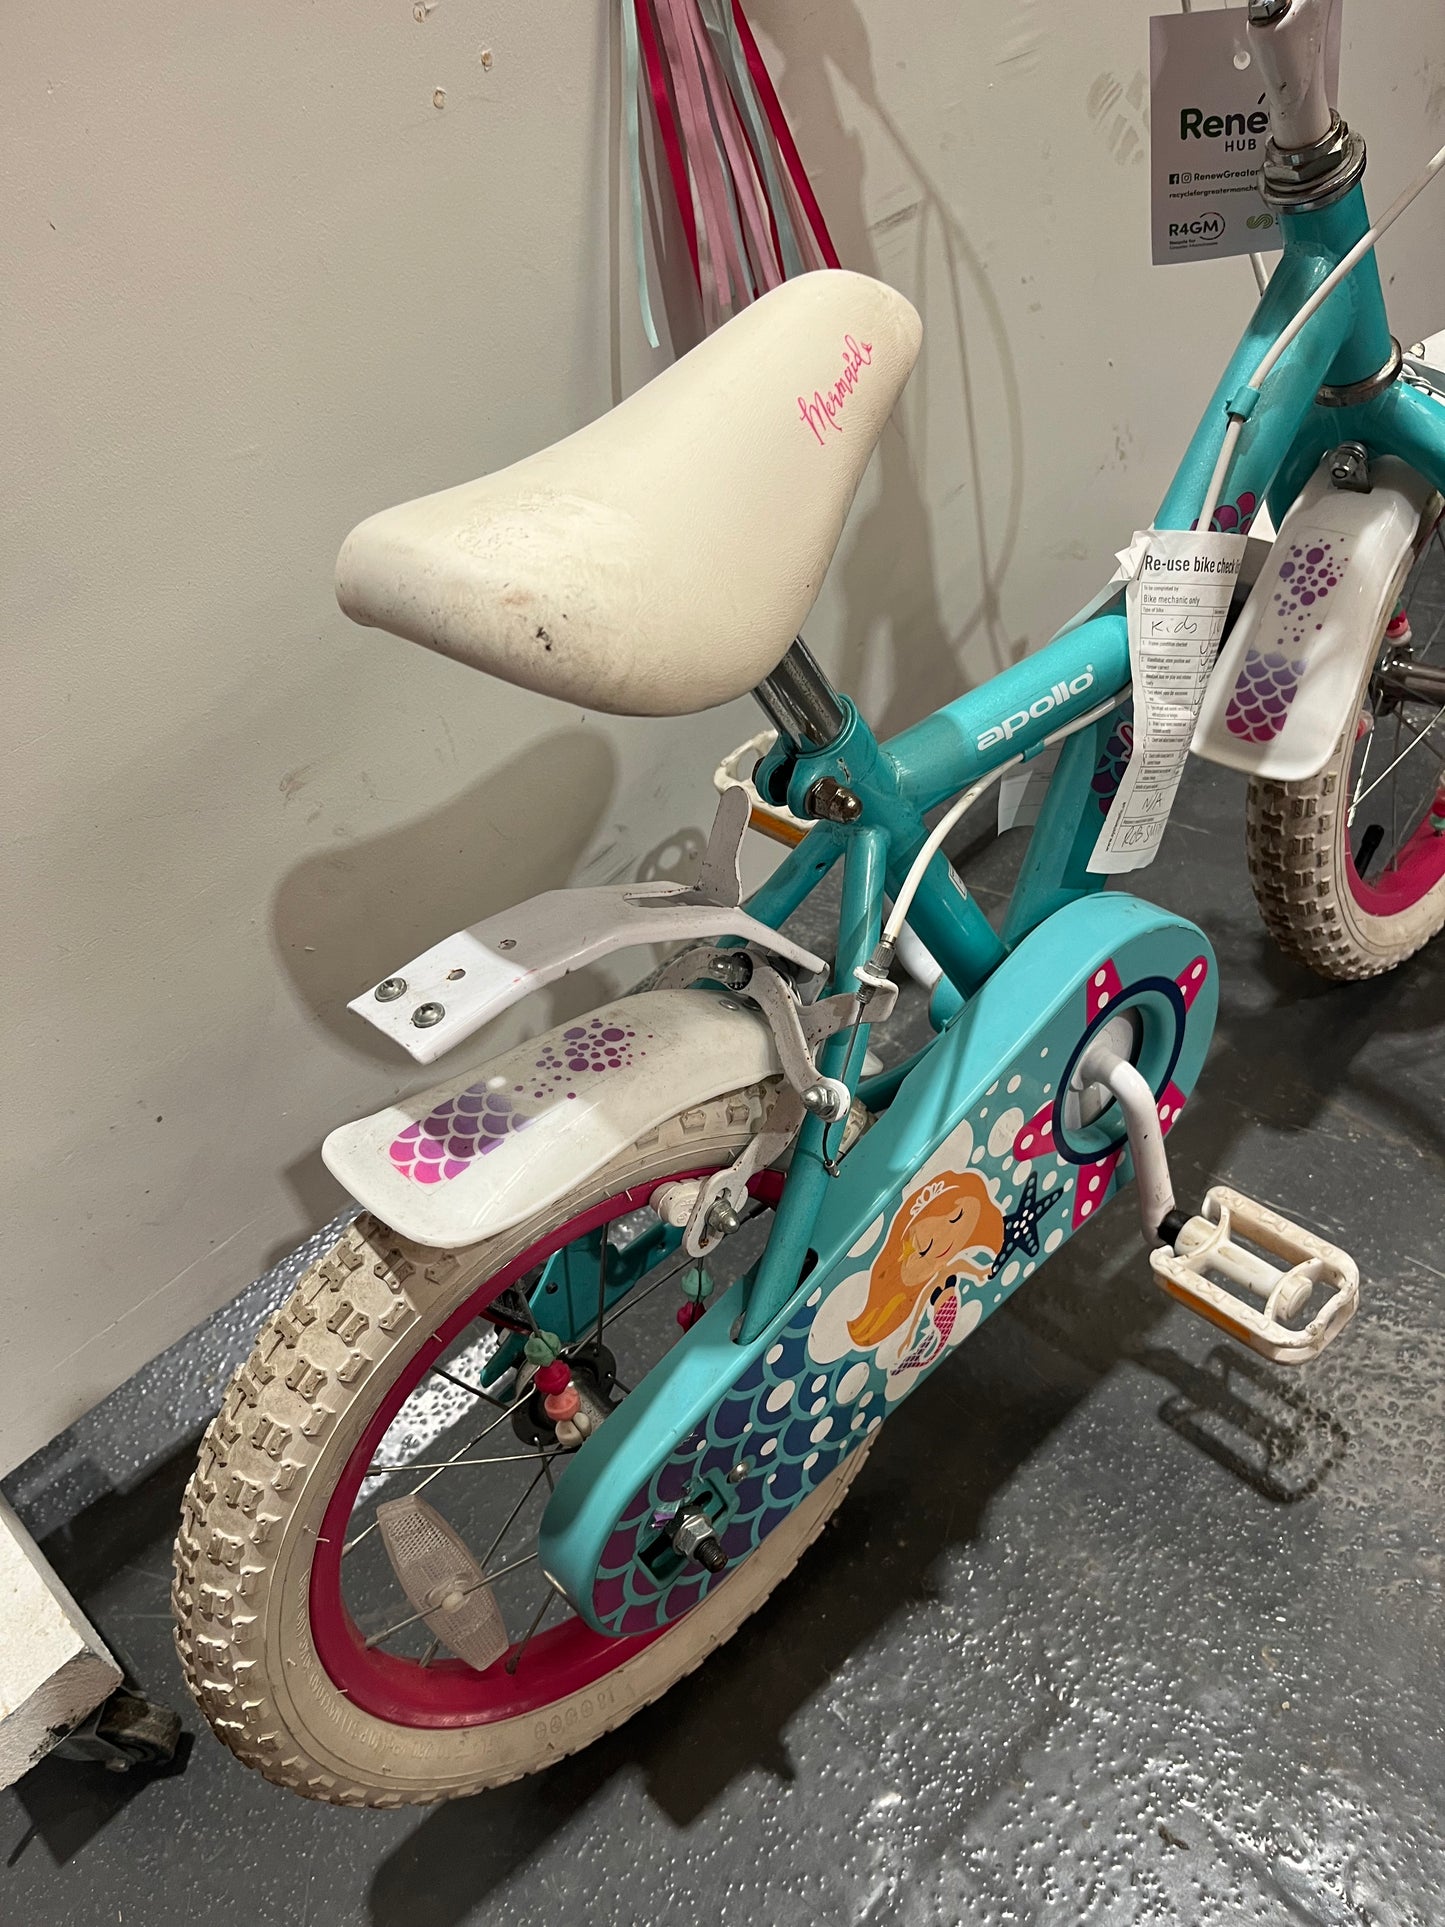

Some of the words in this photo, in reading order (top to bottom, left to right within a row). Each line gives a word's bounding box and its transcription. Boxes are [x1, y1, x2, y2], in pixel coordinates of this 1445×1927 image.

[1225, 139, 1257, 152] HUB
[1194, 169, 1260, 182] RenewGreater
[1169, 184, 1258, 199] recycleforgreatermanche
[1169, 218, 1219, 237] R4GM
[797, 334, 873, 445] Mermaid
[1144, 555, 1190, 572] Re-use
[1193, 556, 1215, 573] bike
[1216, 558, 1235, 574] check
[1143, 595, 1157, 604] Bike
[1158, 595, 1188, 604] mechanic
[1189, 597, 1200, 607] only
[1151, 616, 1198, 637] Kids
[977, 672, 1094, 751] apollo
[1141, 790, 1162, 812] N/A
